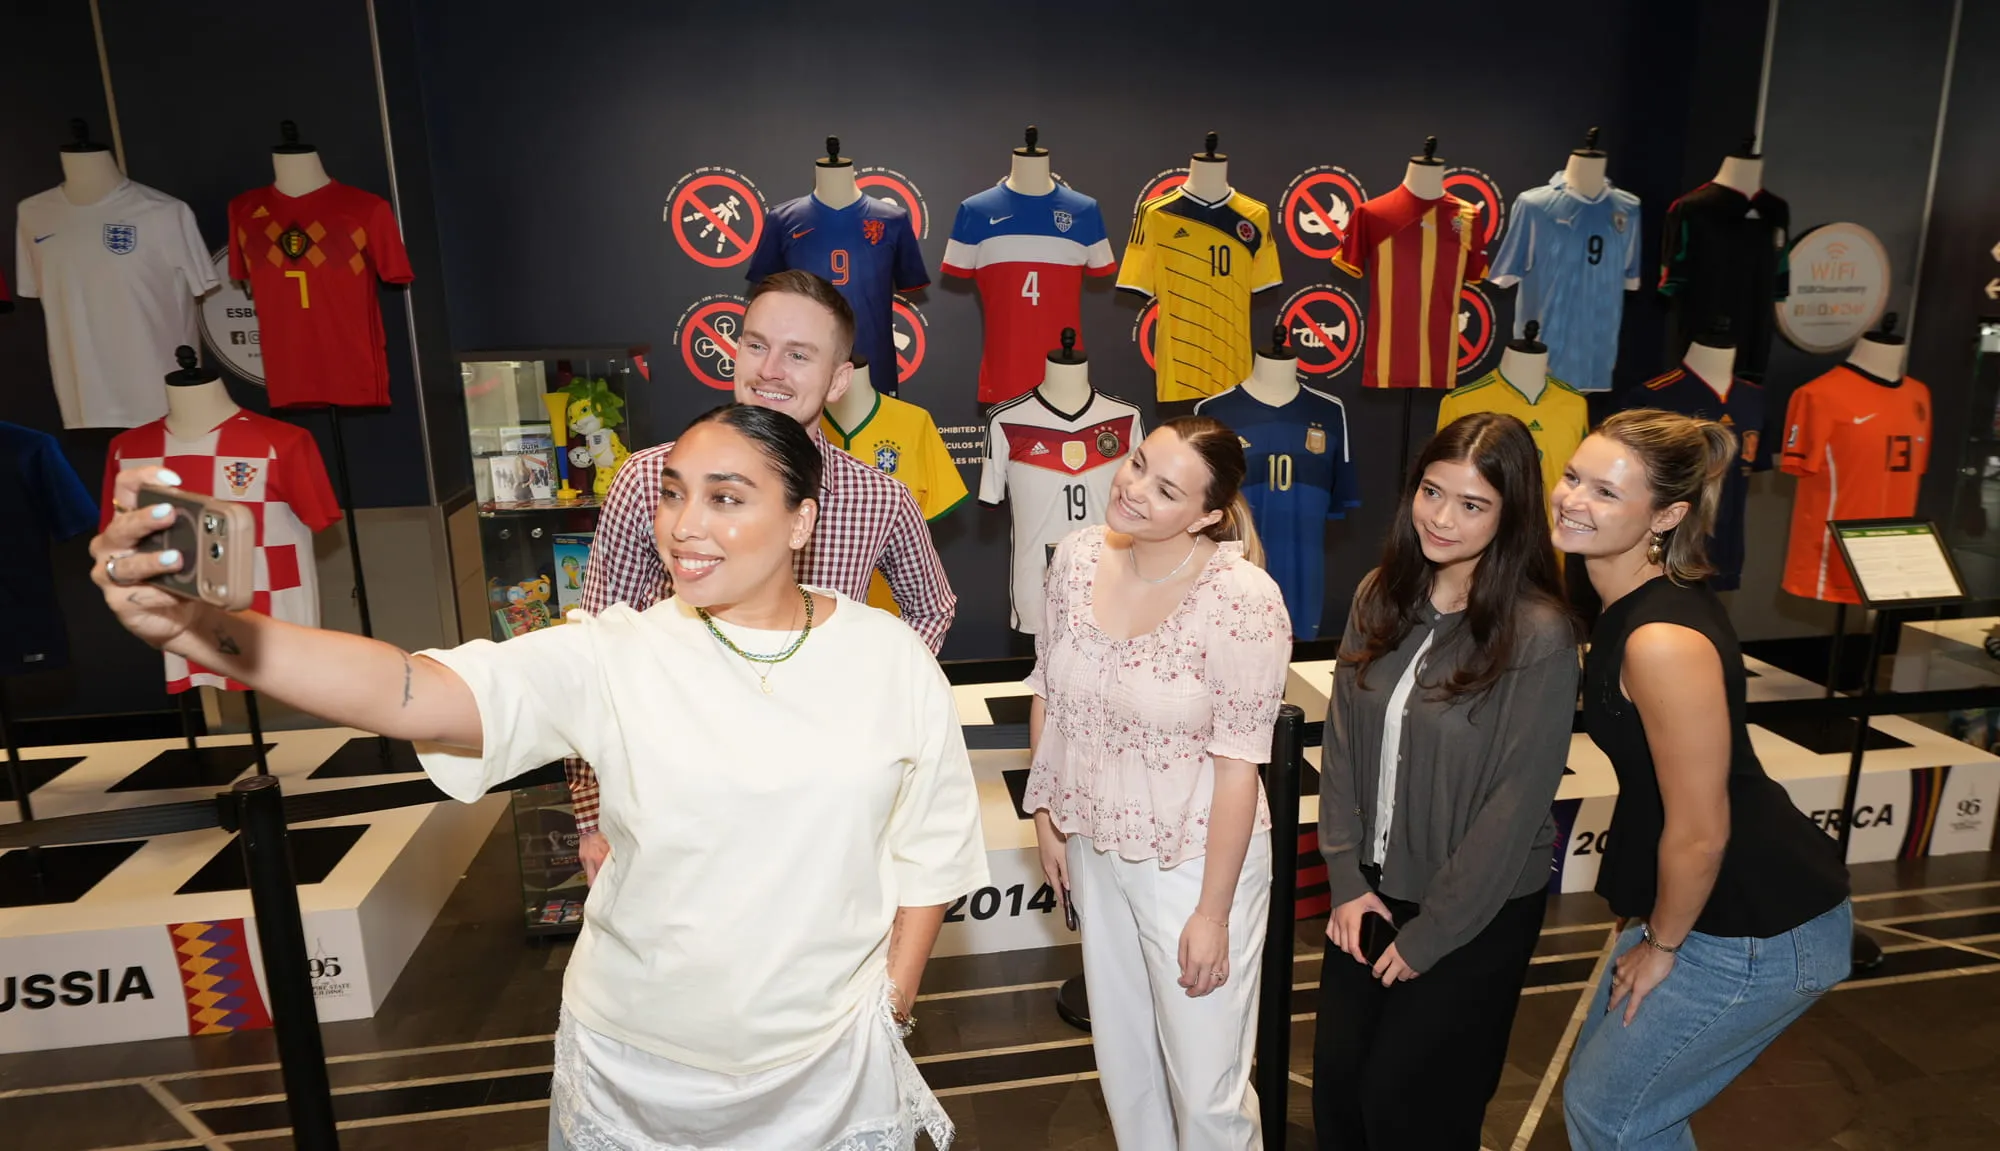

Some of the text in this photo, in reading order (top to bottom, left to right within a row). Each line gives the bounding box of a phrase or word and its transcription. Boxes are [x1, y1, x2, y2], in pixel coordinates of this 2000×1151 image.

[1208, 245, 1231, 276] 10
[1588, 234, 1604, 265] 9
[831, 249, 849, 285] 9
[1811, 262, 1857, 280] WiFi
[285, 270, 309, 308] 7
[1021, 271, 1041, 305] 4
[1887, 435, 1912, 471] 13
[1268, 454, 1292, 491] 10
[1063, 484, 1087, 521] 19
[1810, 804, 1893, 832] FRCA
[1573, 830, 1609, 856] 20
[943, 882, 1057, 923] 2014
[309, 957, 342, 979] 95
